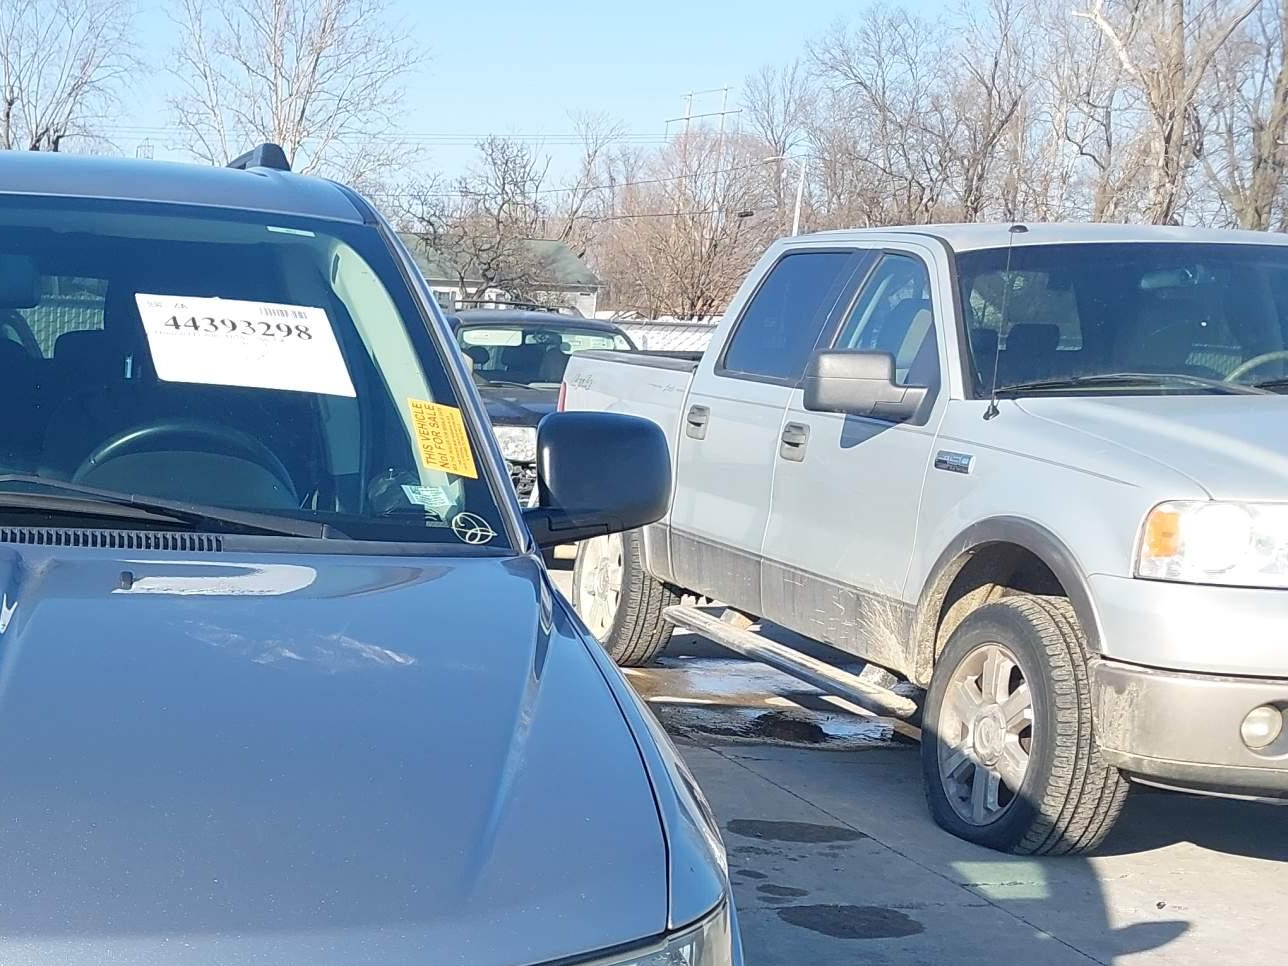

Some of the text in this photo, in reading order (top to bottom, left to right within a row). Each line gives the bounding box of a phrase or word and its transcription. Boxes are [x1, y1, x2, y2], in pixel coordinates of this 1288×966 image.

[164, 315, 313, 341] 44393298
[424, 403, 440, 429] SALE
[412, 401, 437, 465] THIS VEHICLE
[432, 431, 447, 451] FOR
